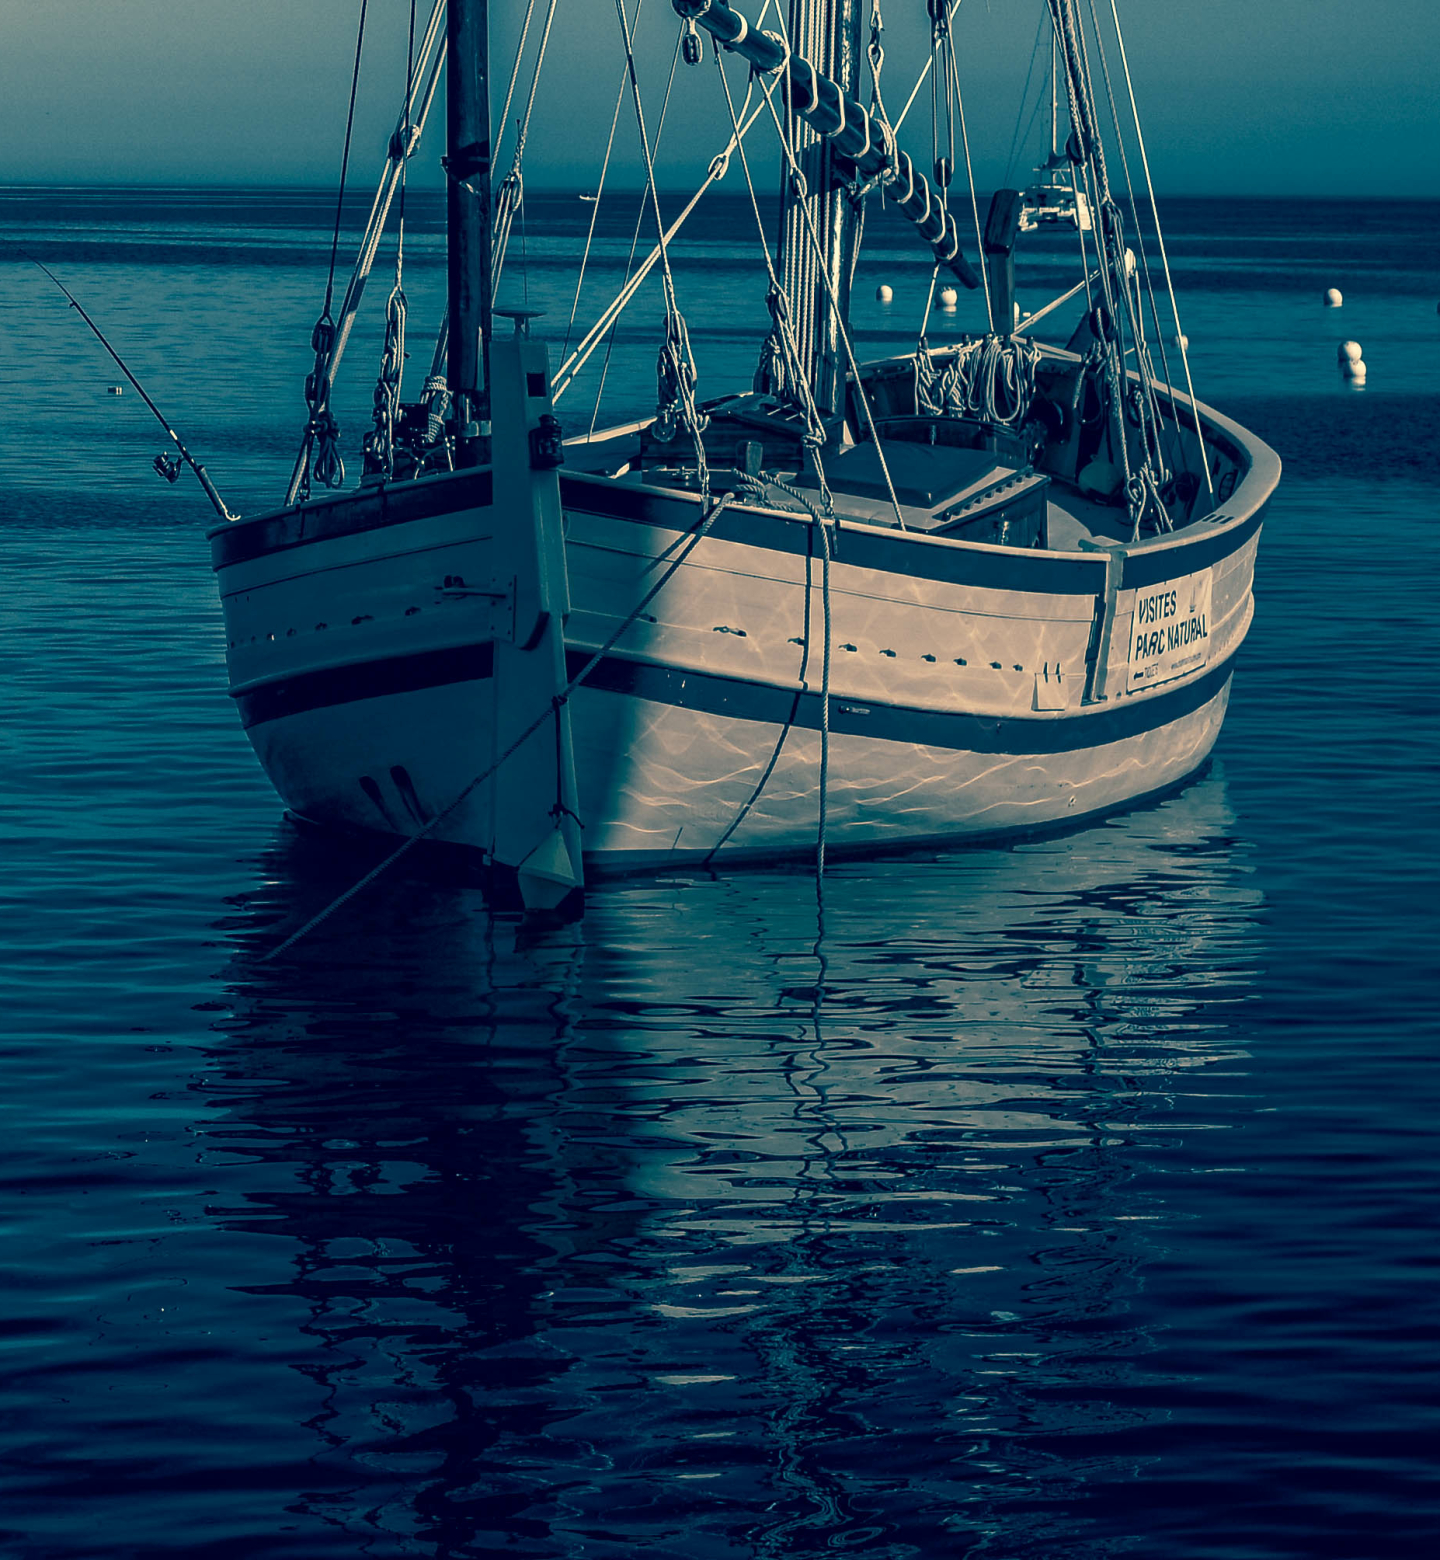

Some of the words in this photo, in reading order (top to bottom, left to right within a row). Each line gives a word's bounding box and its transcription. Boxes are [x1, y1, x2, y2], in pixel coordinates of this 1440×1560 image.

[1139, 590, 1177, 624] VISITES
[1135, 628, 1165, 661] PARC
[1167, 614, 1208, 652] NATURAL
